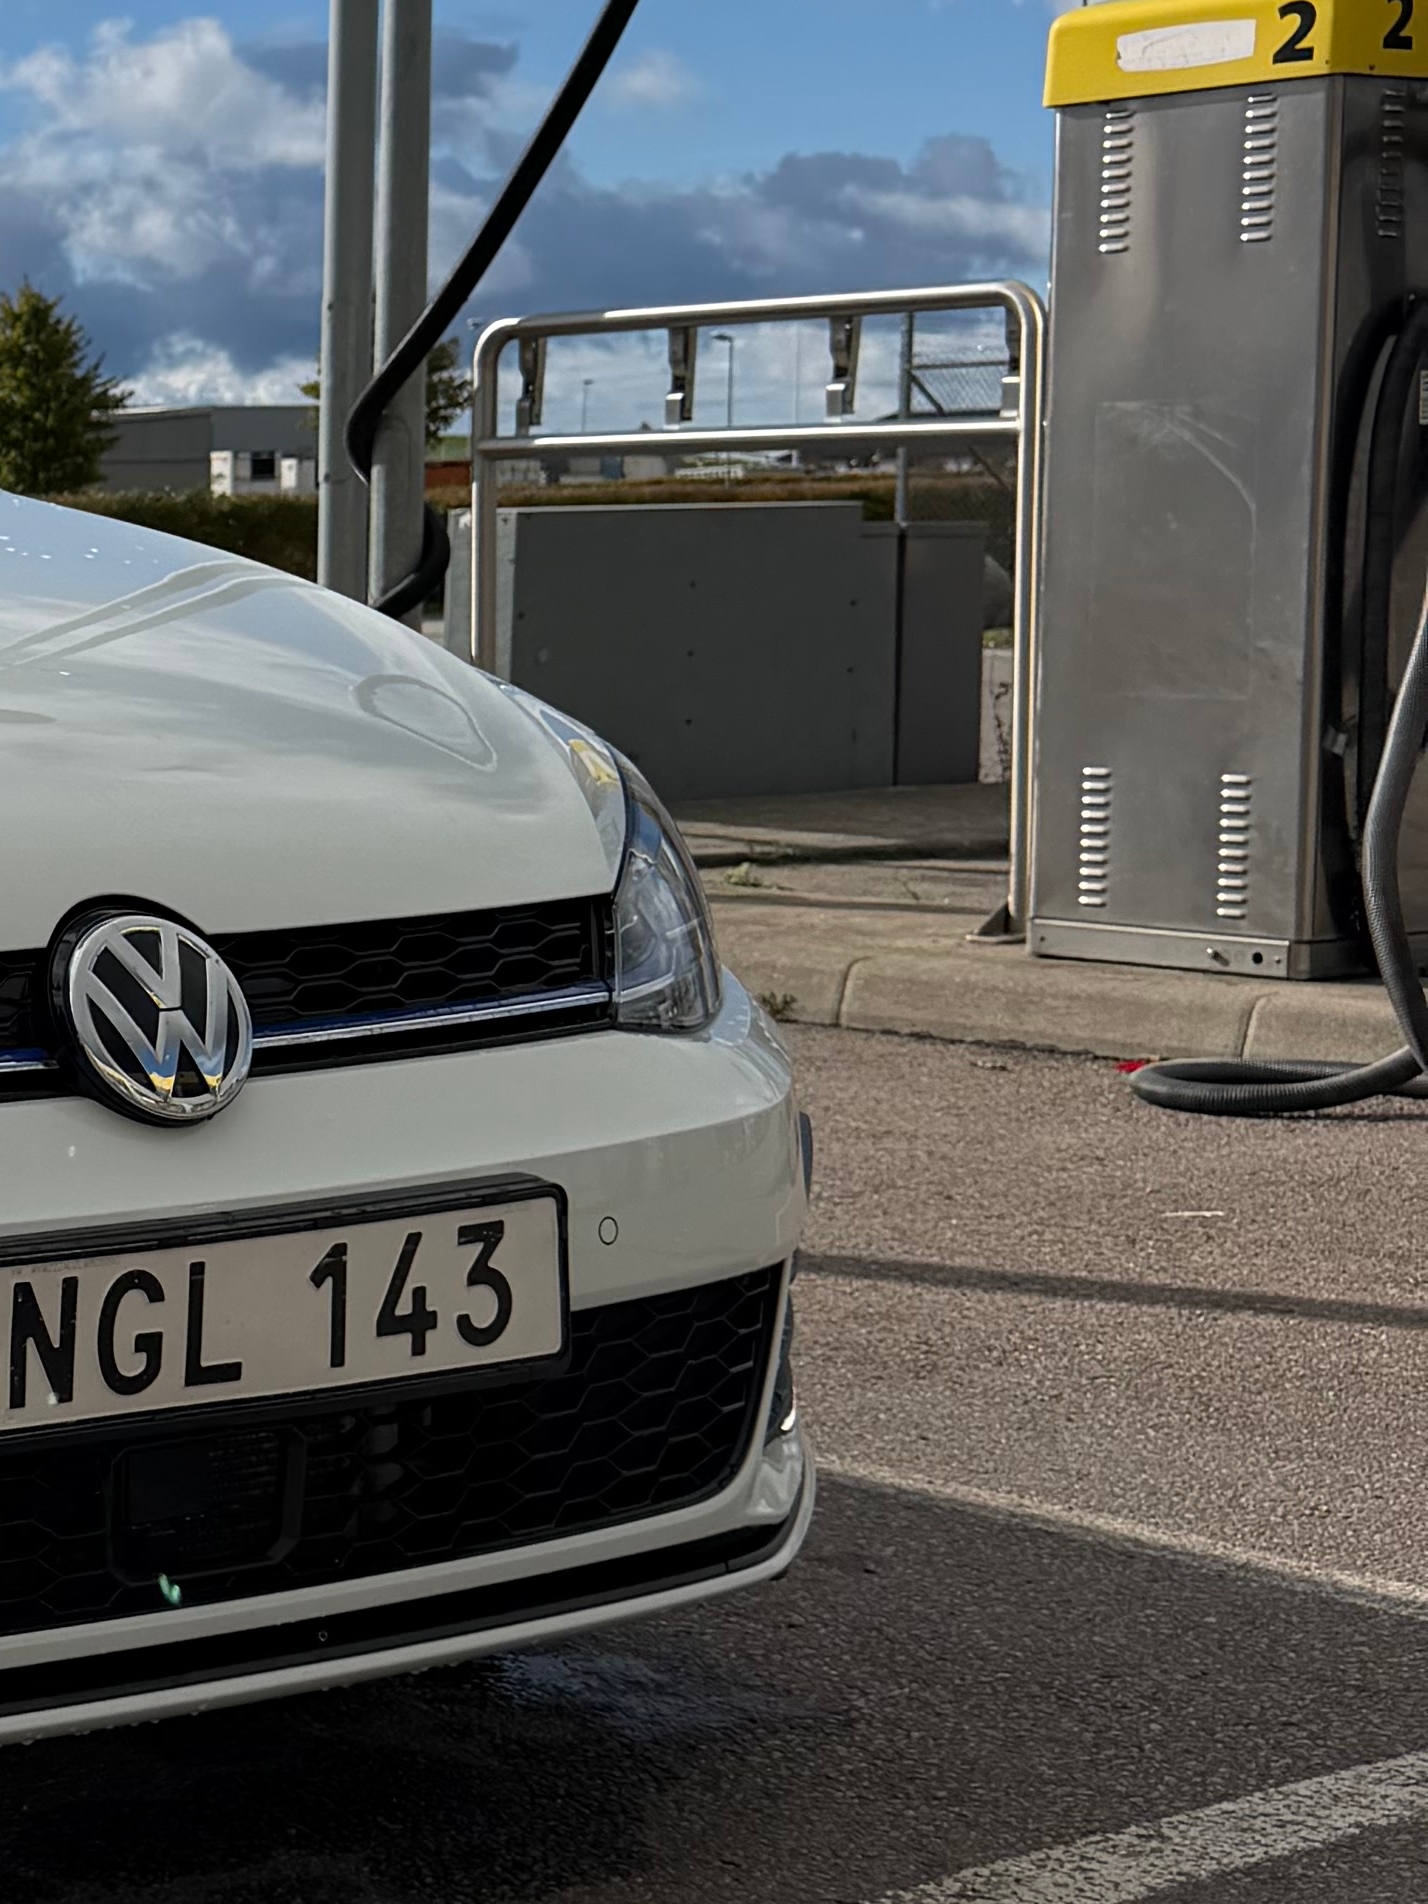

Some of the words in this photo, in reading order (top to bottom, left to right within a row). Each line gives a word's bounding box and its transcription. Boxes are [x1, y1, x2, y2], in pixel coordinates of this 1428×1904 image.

[1272, 0, 1317, 64] 2
[9, 1260, 243, 1409] NGL
[309, 1219, 514, 1369] 143
